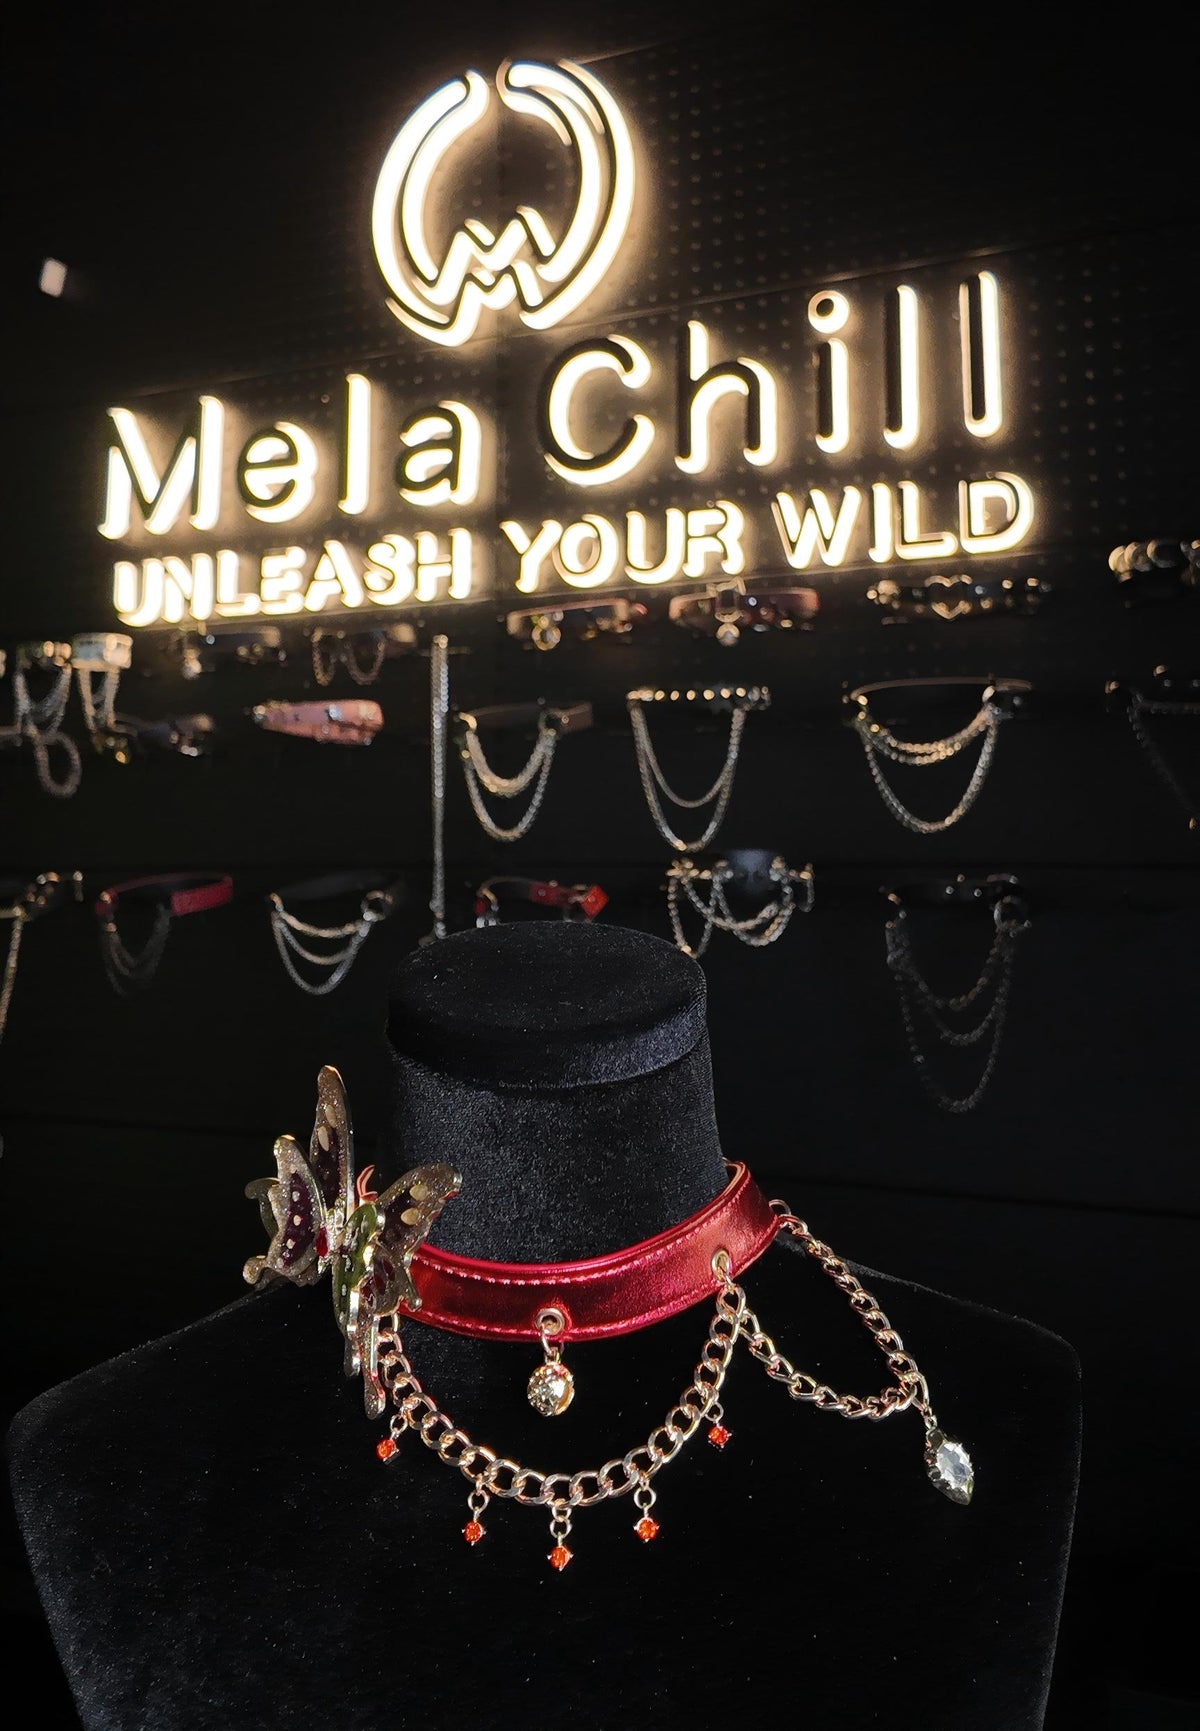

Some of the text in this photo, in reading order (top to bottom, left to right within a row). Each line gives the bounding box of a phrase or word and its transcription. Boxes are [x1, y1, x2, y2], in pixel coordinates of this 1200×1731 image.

[98, 271, 1003, 540] Mela Chill
[113, 472, 1035, 628] UNLEASH YOUR WILD
